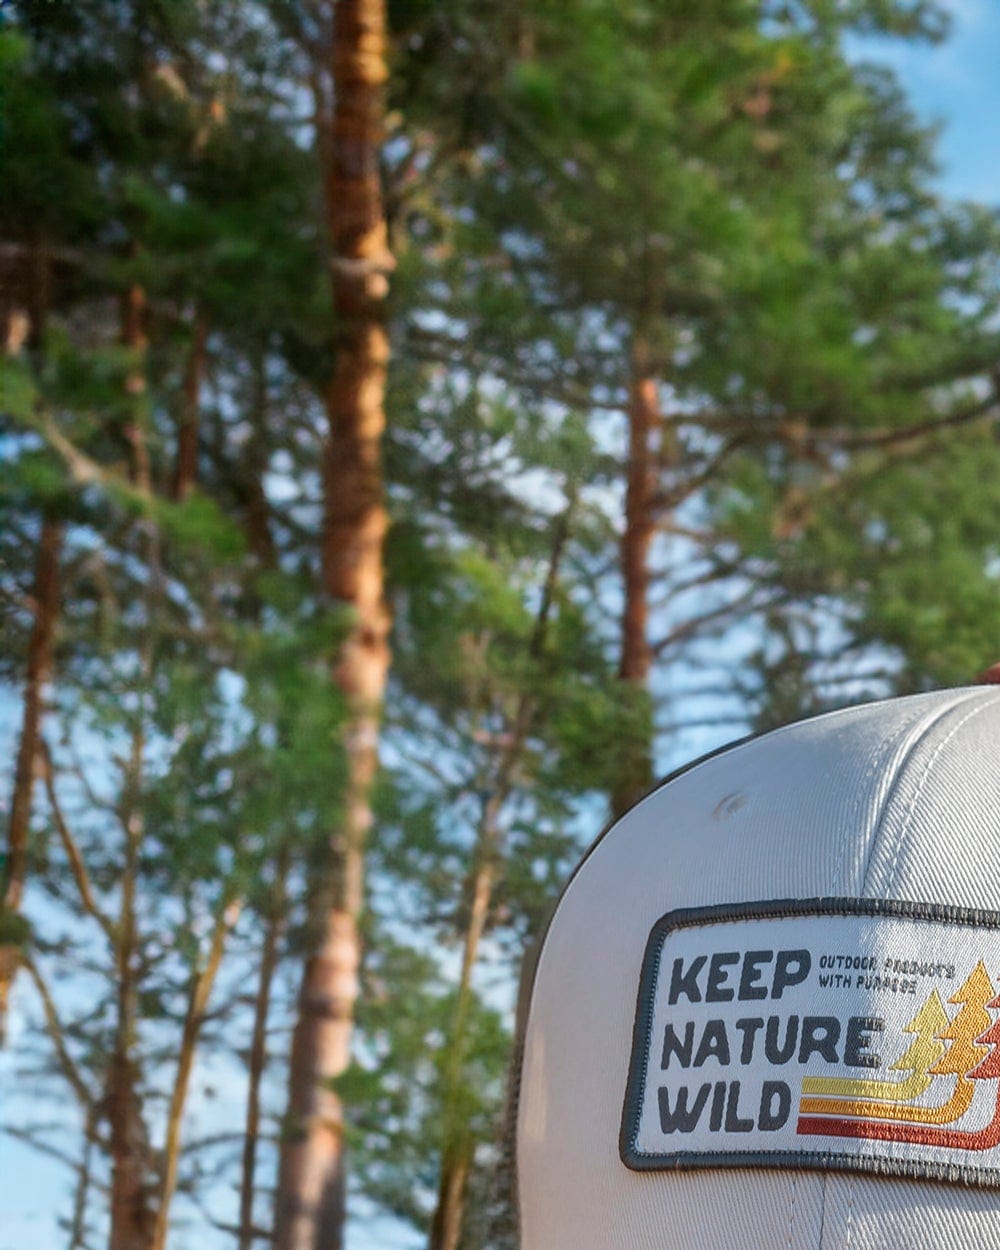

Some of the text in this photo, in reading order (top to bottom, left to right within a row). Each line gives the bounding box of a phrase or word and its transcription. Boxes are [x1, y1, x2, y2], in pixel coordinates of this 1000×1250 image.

[668, 949, 811, 1005] KEEP
[819, 955, 877, 971] OUTDOOR
[819, 974, 852, 988] WITH
[660, 1015, 886, 1070] NATURE
[657, 1080, 792, 1135] WILD
